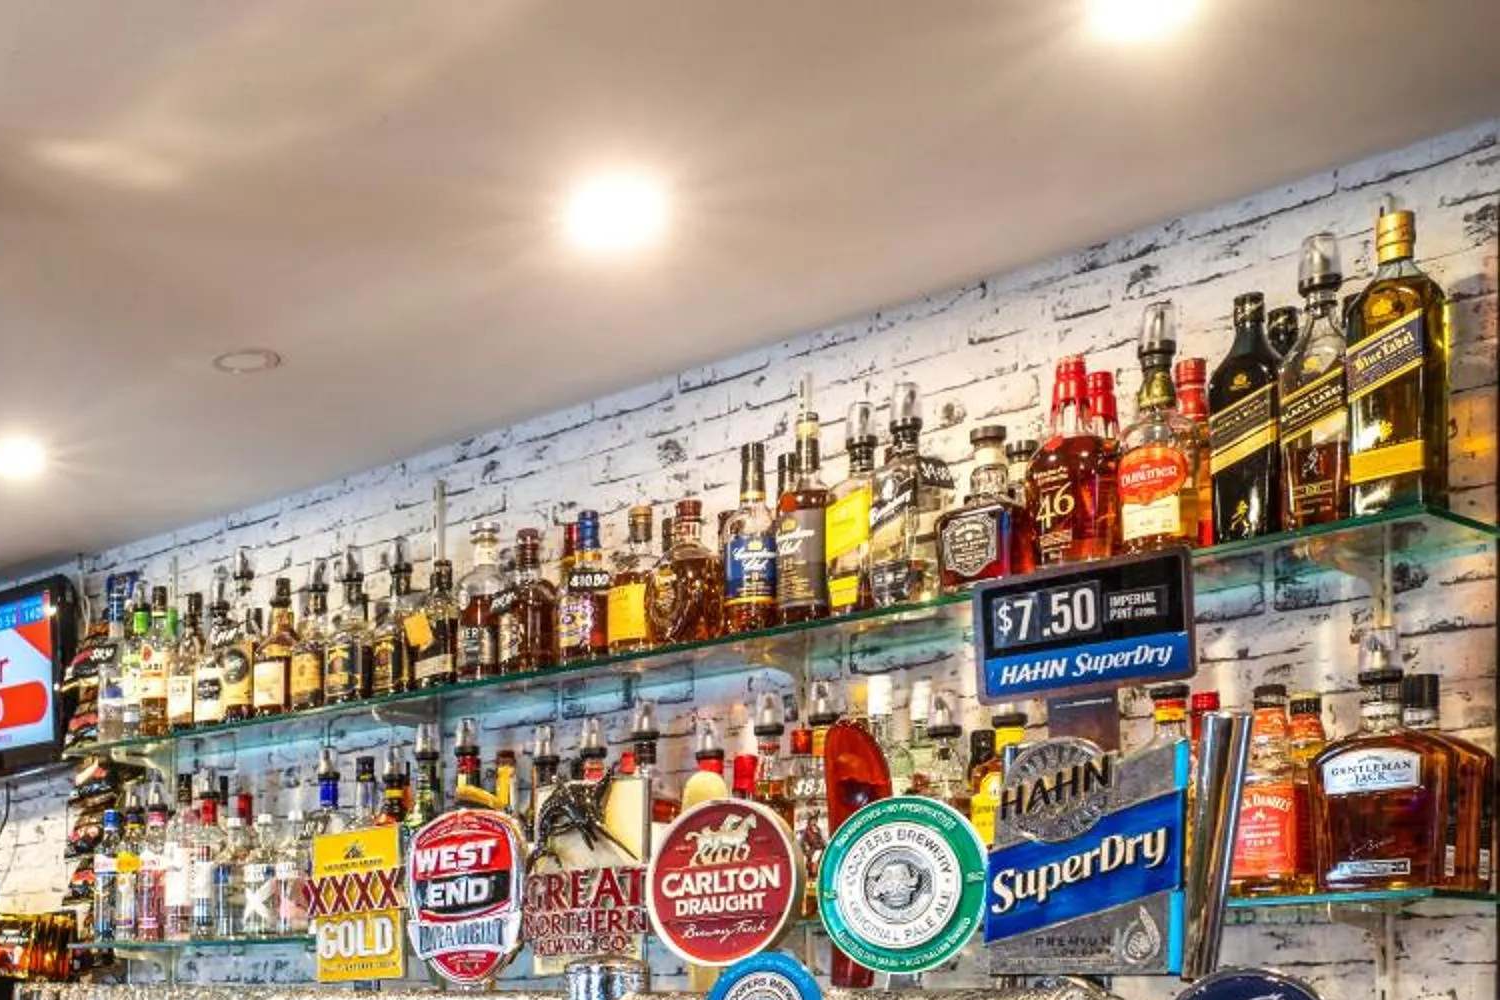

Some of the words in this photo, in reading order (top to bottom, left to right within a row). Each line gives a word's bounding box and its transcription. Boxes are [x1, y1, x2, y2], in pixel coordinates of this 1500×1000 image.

[1035, 481, 1076, 529] 46
[1109, 591, 1157, 606] IMPERIAL
[1109, 607, 1134, 621] PINT
[1000, 657, 1068, 686] HAHN
[1071, 644, 1173, 678] SuperDry
[1331, 759, 1412, 777] GENTLEMAN
[1000, 754, 1113, 821] HAHN
[415, 839, 497, 874] WEST
[990, 827, 1168, 914] SuperDry
[302, 866, 405, 916] XXXX
[427, 878, 491, 907] END
[527, 867, 647, 911] GREAT
[661, 864, 780, 898] CARLTON
[675, 892, 766, 917] DRAUGHT
[319, 917, 393, 959] GOLD
[524, 909, 648, 938] NORTHERN
